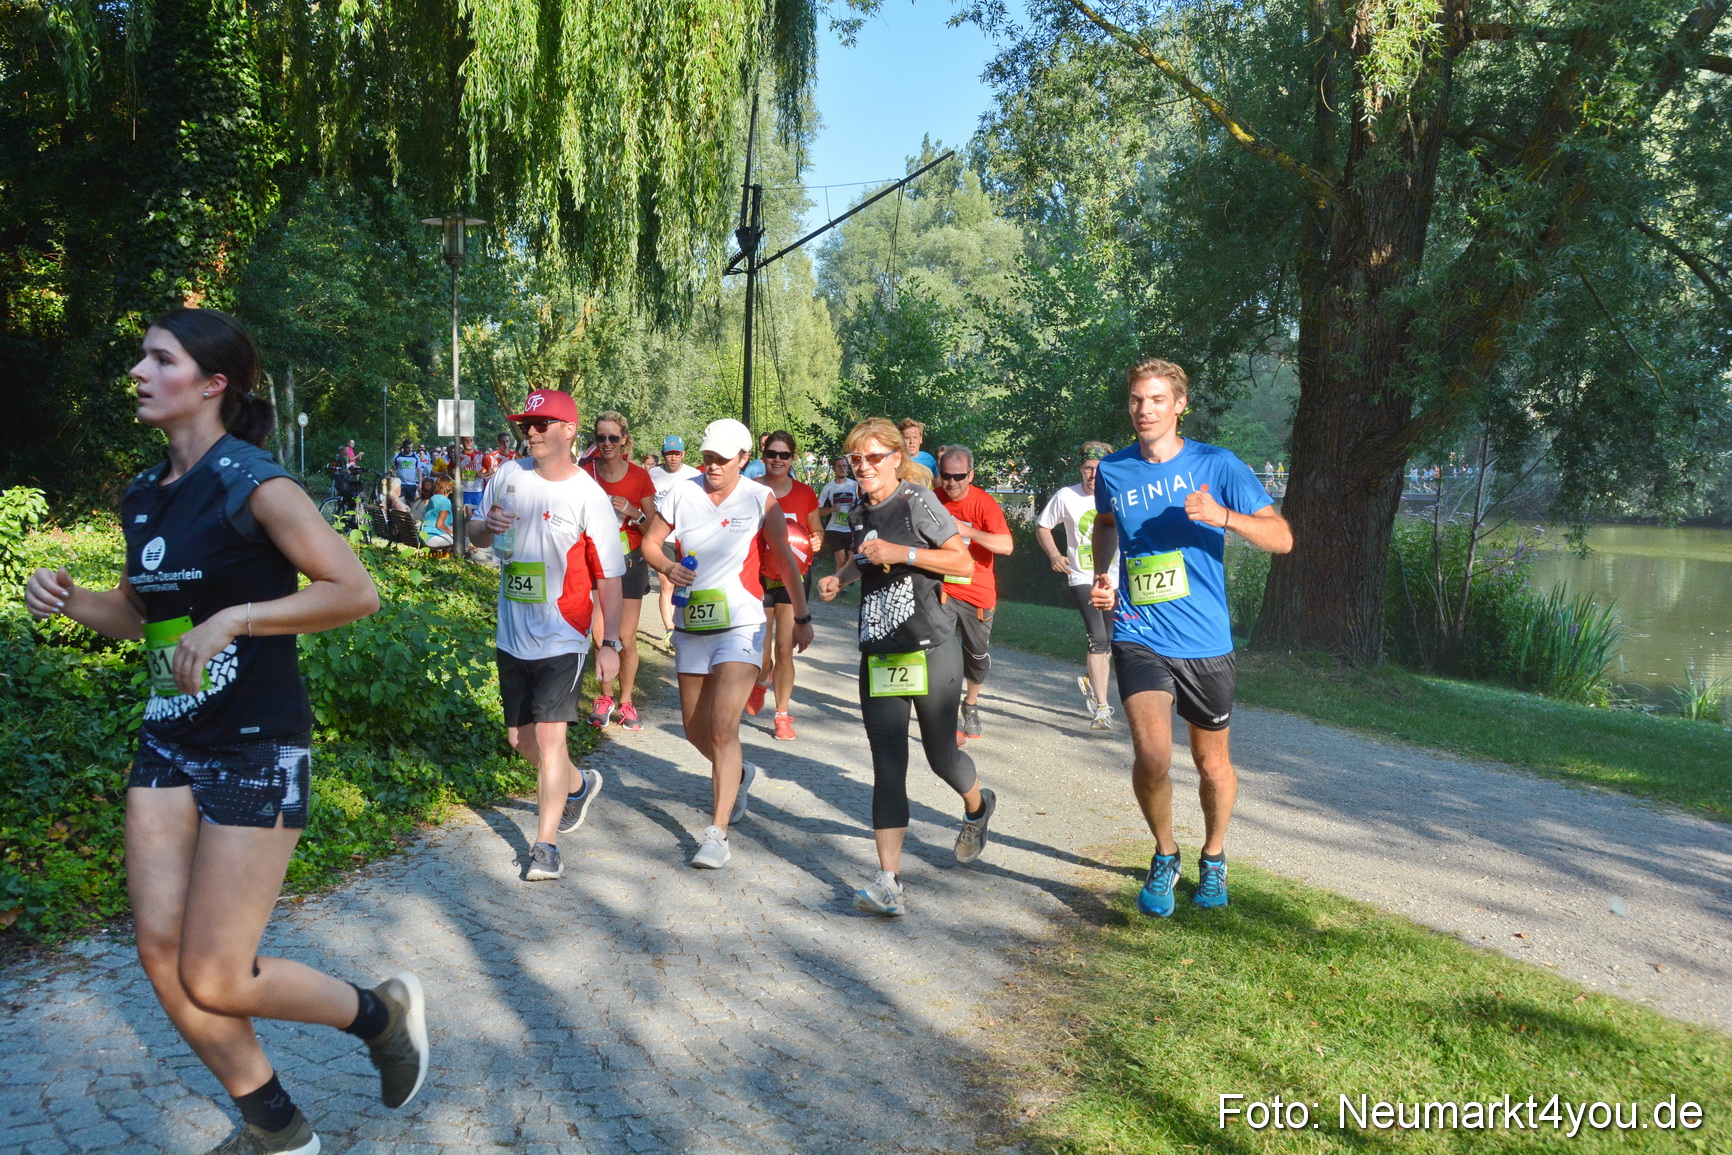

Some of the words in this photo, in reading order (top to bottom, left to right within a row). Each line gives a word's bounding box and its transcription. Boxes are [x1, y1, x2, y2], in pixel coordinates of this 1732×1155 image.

[508, 574, 533, 591] 254
[1134, 569, 1176, 591] 1727
[689, 603, 715, 619] 257
[887, 667, 909, 683] 72
